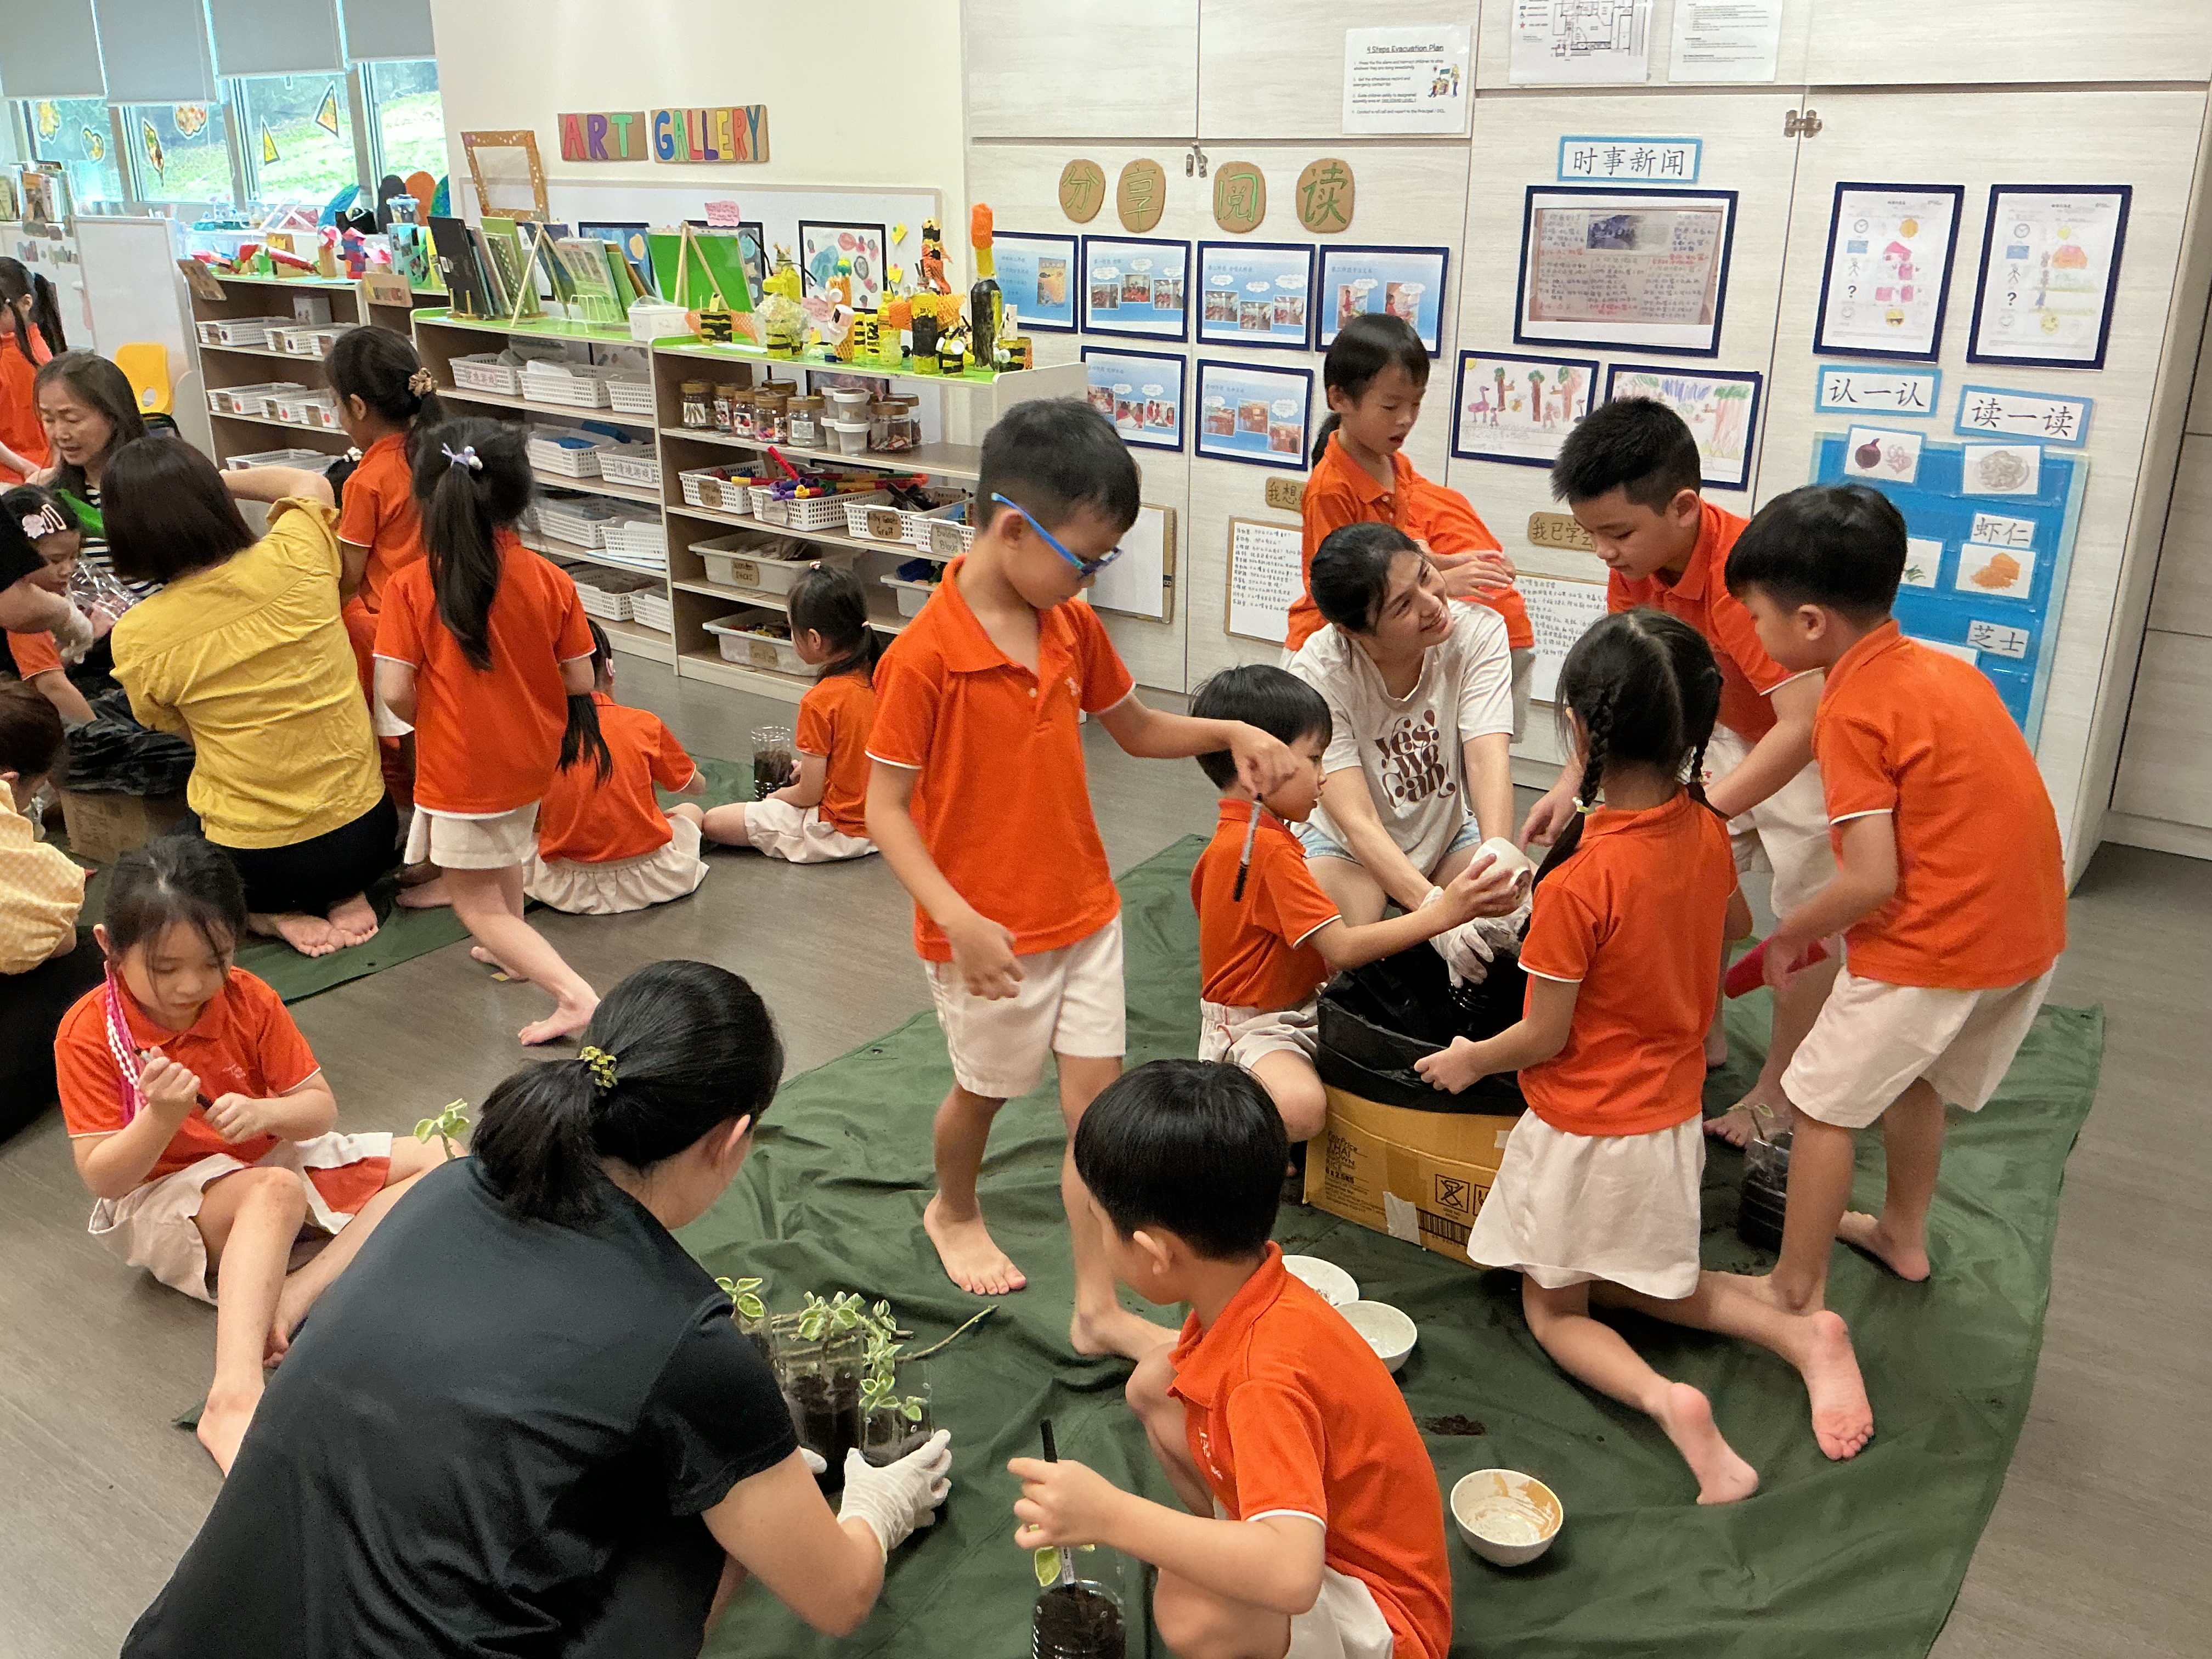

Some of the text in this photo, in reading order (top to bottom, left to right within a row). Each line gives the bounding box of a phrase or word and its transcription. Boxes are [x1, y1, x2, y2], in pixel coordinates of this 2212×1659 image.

[1391, 44, 1427, 53] Evacuation
[1429, 43, 1444, 52] Plan
[564, 104, 761, 161] ART GALLERY
[1573, 146, 1686, 176] 时事新闻
[1062, 162, 1349, 229] 分享阅读
[1829, 379, 1925, 409] 认一认
[1971, 398, 2074, 438] 读一读
[1268, 481, 1303, 505] 我想
[1973, 519, 2029, 545] 虾仁
[1968, 625, 2025, 653] 芝士
[1393, 744, 1439, 778] we
[1328, 1130, 1358, 1152] FairPrice
[1329, 1141, 1351, 1158] THAI
